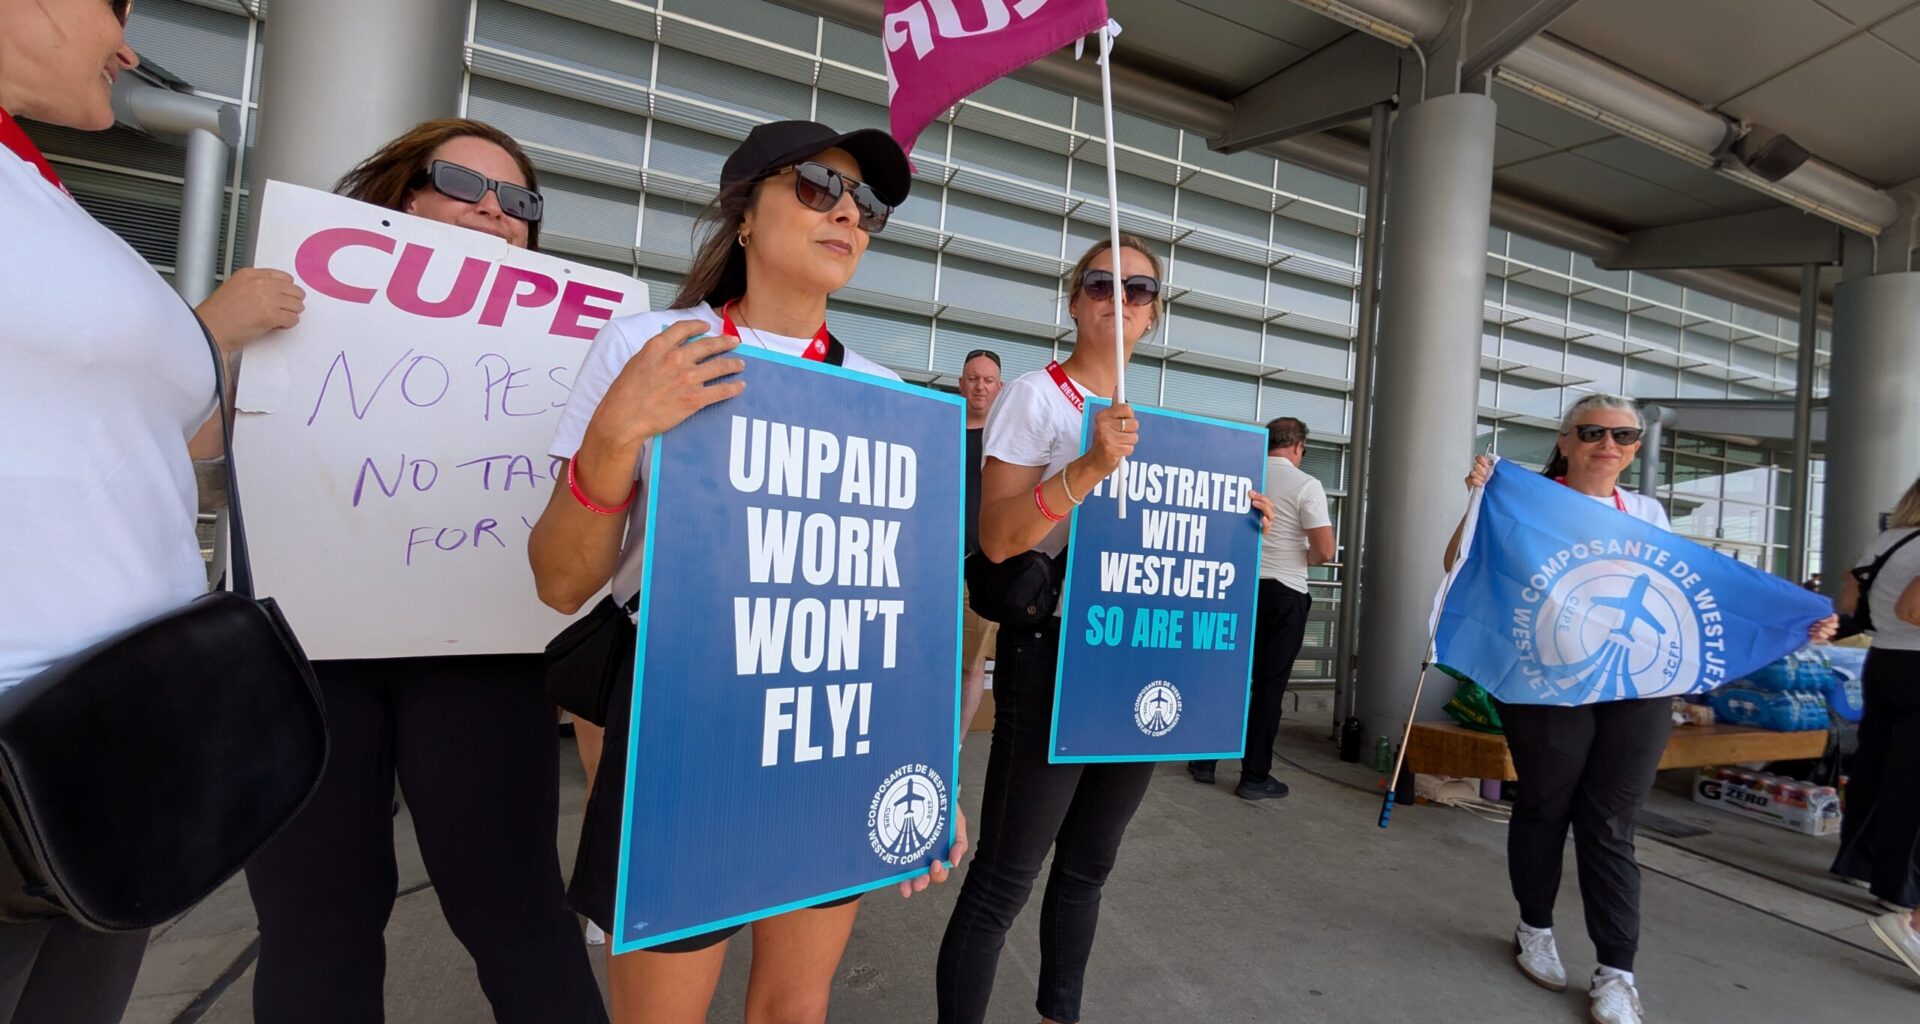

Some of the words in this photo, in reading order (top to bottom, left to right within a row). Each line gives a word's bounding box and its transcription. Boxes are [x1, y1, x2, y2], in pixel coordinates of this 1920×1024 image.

[294, 227, 625, 341] CUPE
[307, 348, 449, 426] NO
[353, 454, 438, 507] NO
[729, 414, 917, 510] UNPAID
[407, 518, 505, 566] FOR
[746, 506, 901, 588] WORK
[1142, 509, 1207, 554] WITH
[1100, 551, 1236, 600] WESTJET?
[734, 597, 904, 675] WON'T
[1085, 604, 1124, 646] SO
[1131, 607, 1184, 649] ARE
[1192, 611, 1238, 651] WE!
[1521, 539, 1671, 603] COMPOSANTE
[1669, 560, 1701, 589] DE
[1694, 588, 1726, 691] WESTJET
[1558, 596, 1581, 633] CUPE
[1512, 607, 1559, 699] WESTJET
[1662, 641, 1679, 677] SCFP
[761, 682, 873, 767] FLY!
[867, 764, 913, 827] COMPOSANTE
[915, 764, 928, 774] DE
[927, 768, 948, 812] WESTJET
[1724, 787, 1768, 807] ZERO
[868, 829, 899, 864] WESTJET
[900, 816, 946, 865] COMPONENT
